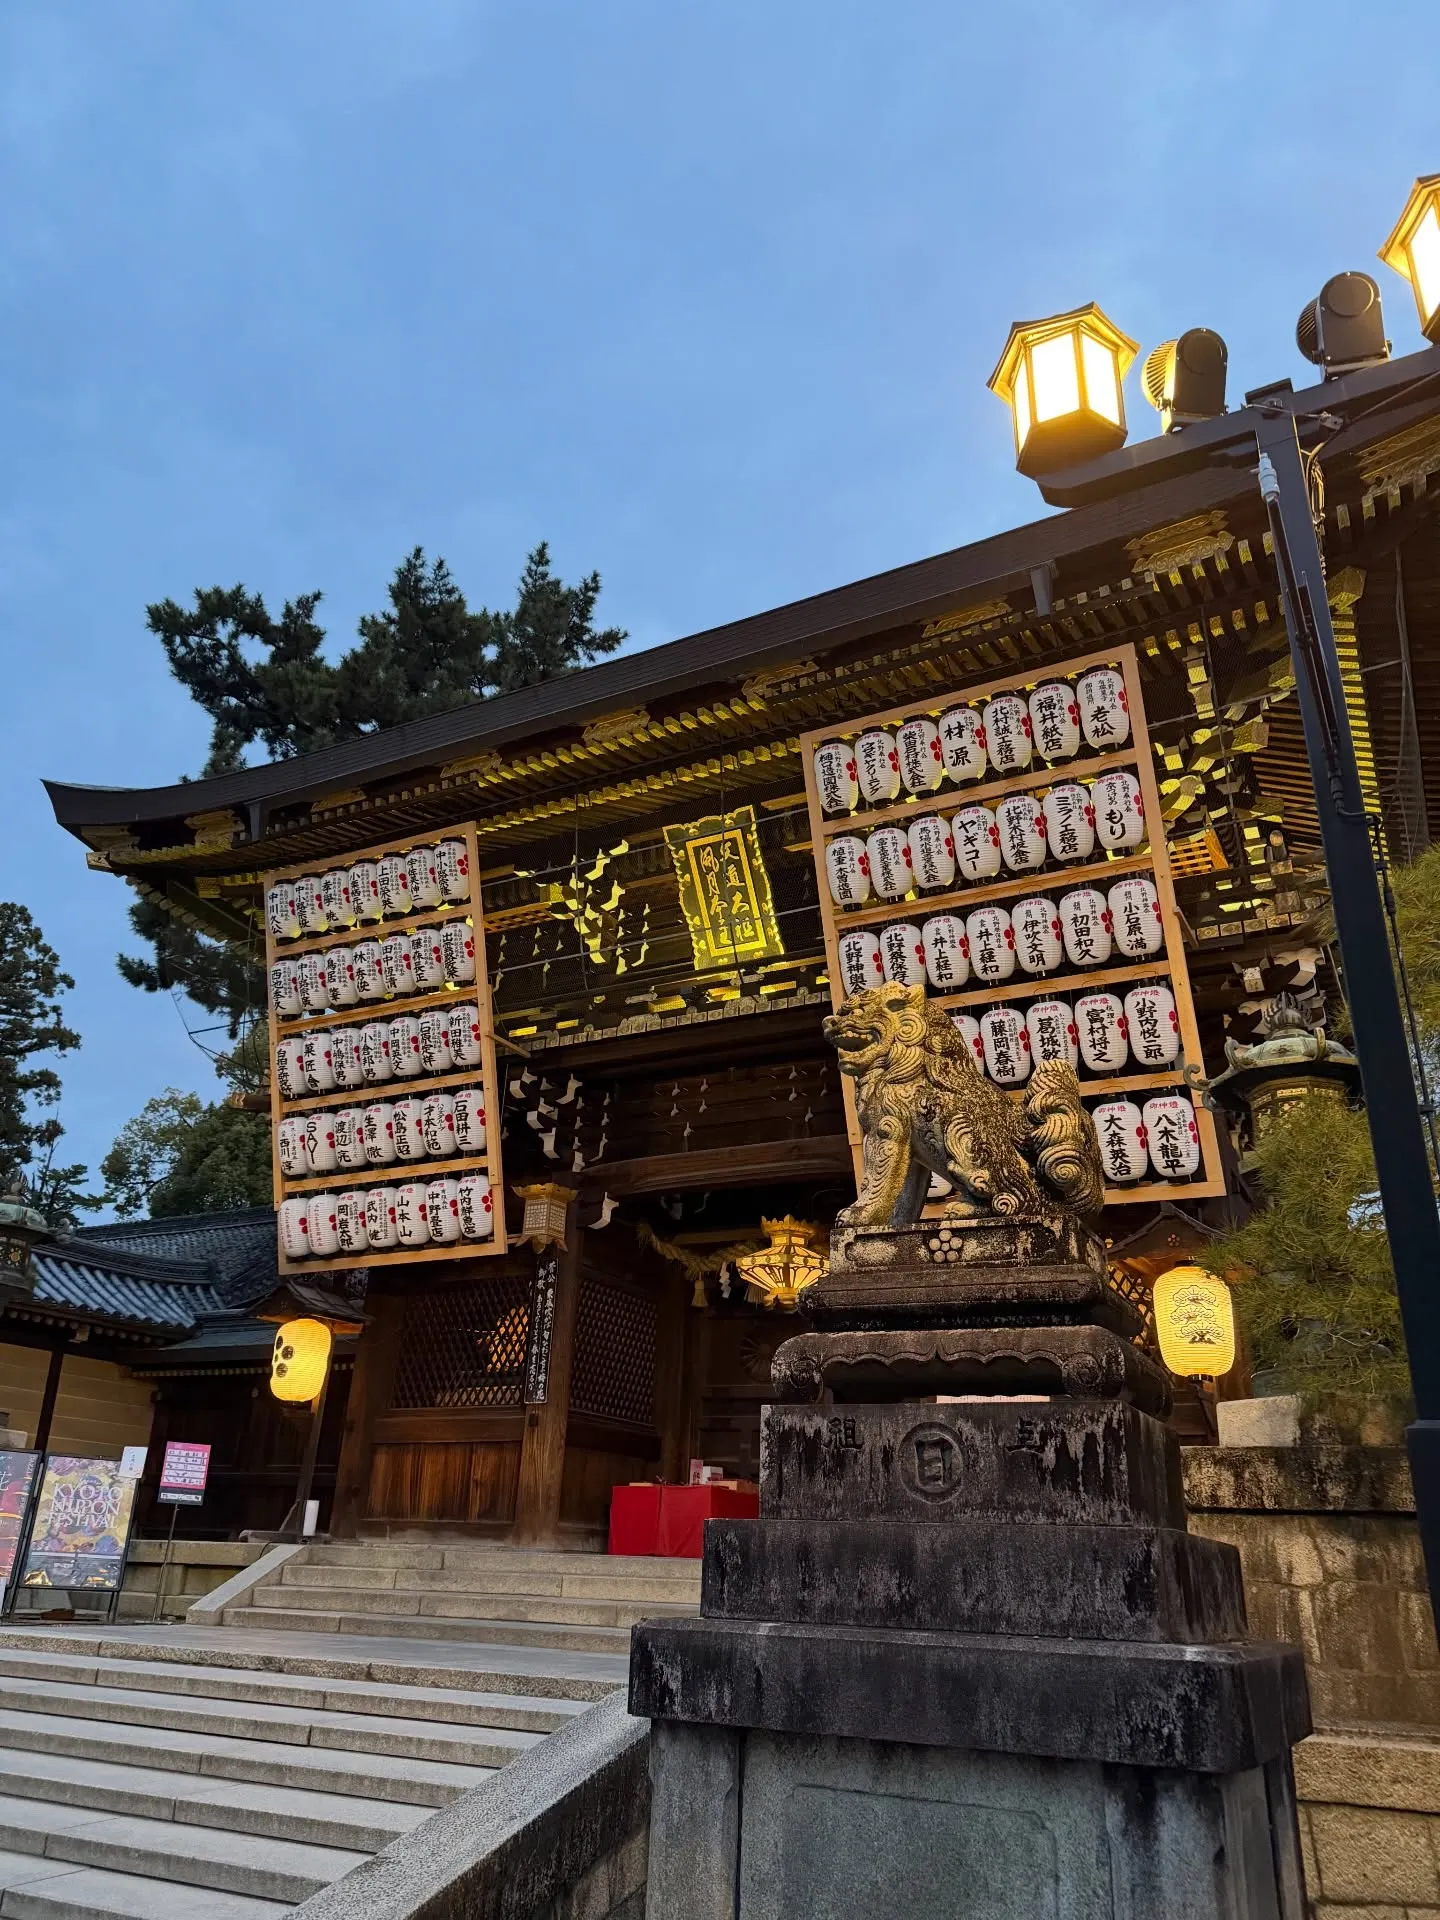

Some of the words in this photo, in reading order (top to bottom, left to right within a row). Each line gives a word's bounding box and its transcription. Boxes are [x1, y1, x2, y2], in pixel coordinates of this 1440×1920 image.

[944, 721, 971, 767] 材源
[1035, 695, 1063, 754] 福井紙店
[1090, 705, 1117, 739] 老松
[958, 820, 980, 871] ヤギコー
[1104, 809, 1126, 840] もり
[268, 892, 283, 935] 中川久公
[1123, 901, 1147, 951] 小石原満
[886, 932, 911, 988] 北野祭保存
[931, 935, 954, 983] 井上経和
[1022, 920, 1047, 968] 伊吹文明
[1070, 913, 1100, 961] 初田和久
[390, 1027, 405, 1071] 中岡英文
[990, 1019, 1016, 1078] 藤岡春樹
[1134, 998, 1164, 1060] 小野内悦二郎
[307, 1122, 318, 1164] SAY
[393, 1110, 411, 1156] 松島正昭
[454, 1100, 472, 1146] 石田耕三
[1103, 1114, 1131, 1177] 大森英治
[1154, 1114, 1185, 1174] 八木龍平
[338, 1204, 354, 1248] 岡岩太郎
[397, 1196, 413, 1238] 山本山
[51, 1498, 121, 1516] NIPPON
[53, 1483, 123, 1501] KYOTO
[47, 1512, 118, 1528] FESTIVAL
